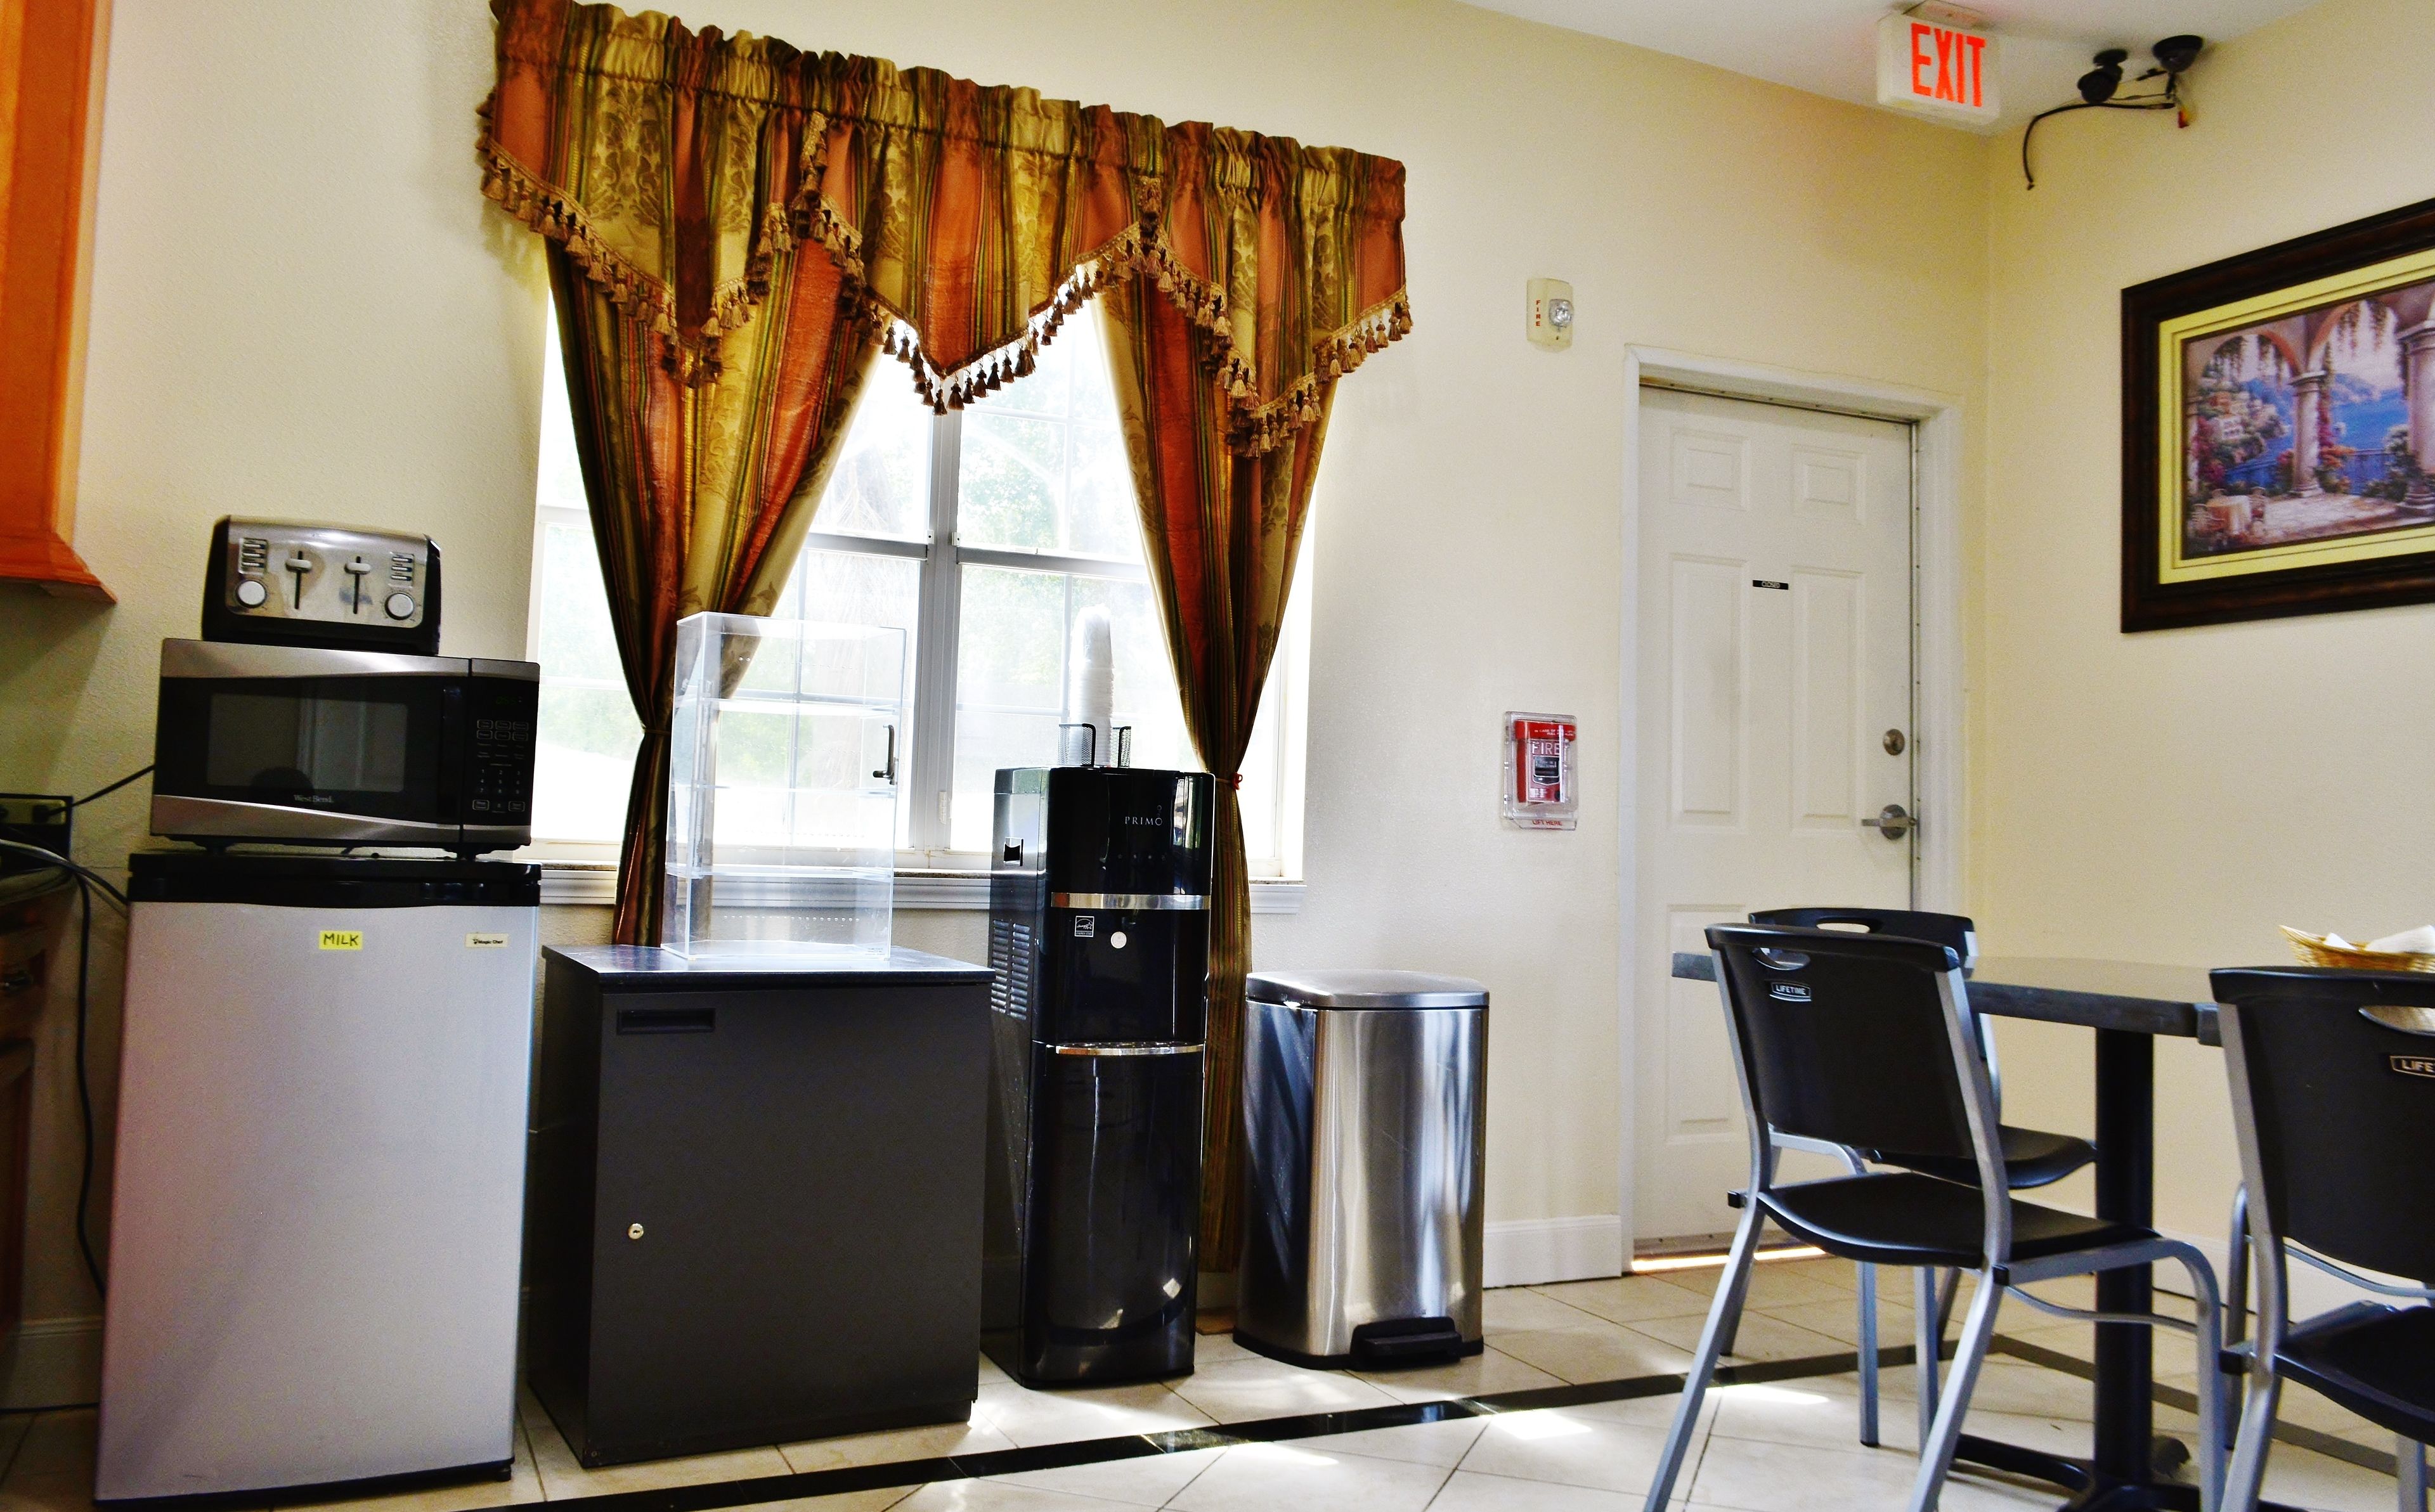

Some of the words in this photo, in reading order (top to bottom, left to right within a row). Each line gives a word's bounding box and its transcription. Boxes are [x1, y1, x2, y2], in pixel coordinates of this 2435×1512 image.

[1911, 22, 1987, 108] EXIT
[1531, 741, 1560, 755] FIRE
[1125, 816, 1163, 826] PRIMO
[323, 933, 358, 947] MILK
[1776, 985, 1806, 995] LIFETIME
[2401, 1059, 2435, 1073] LIFE
